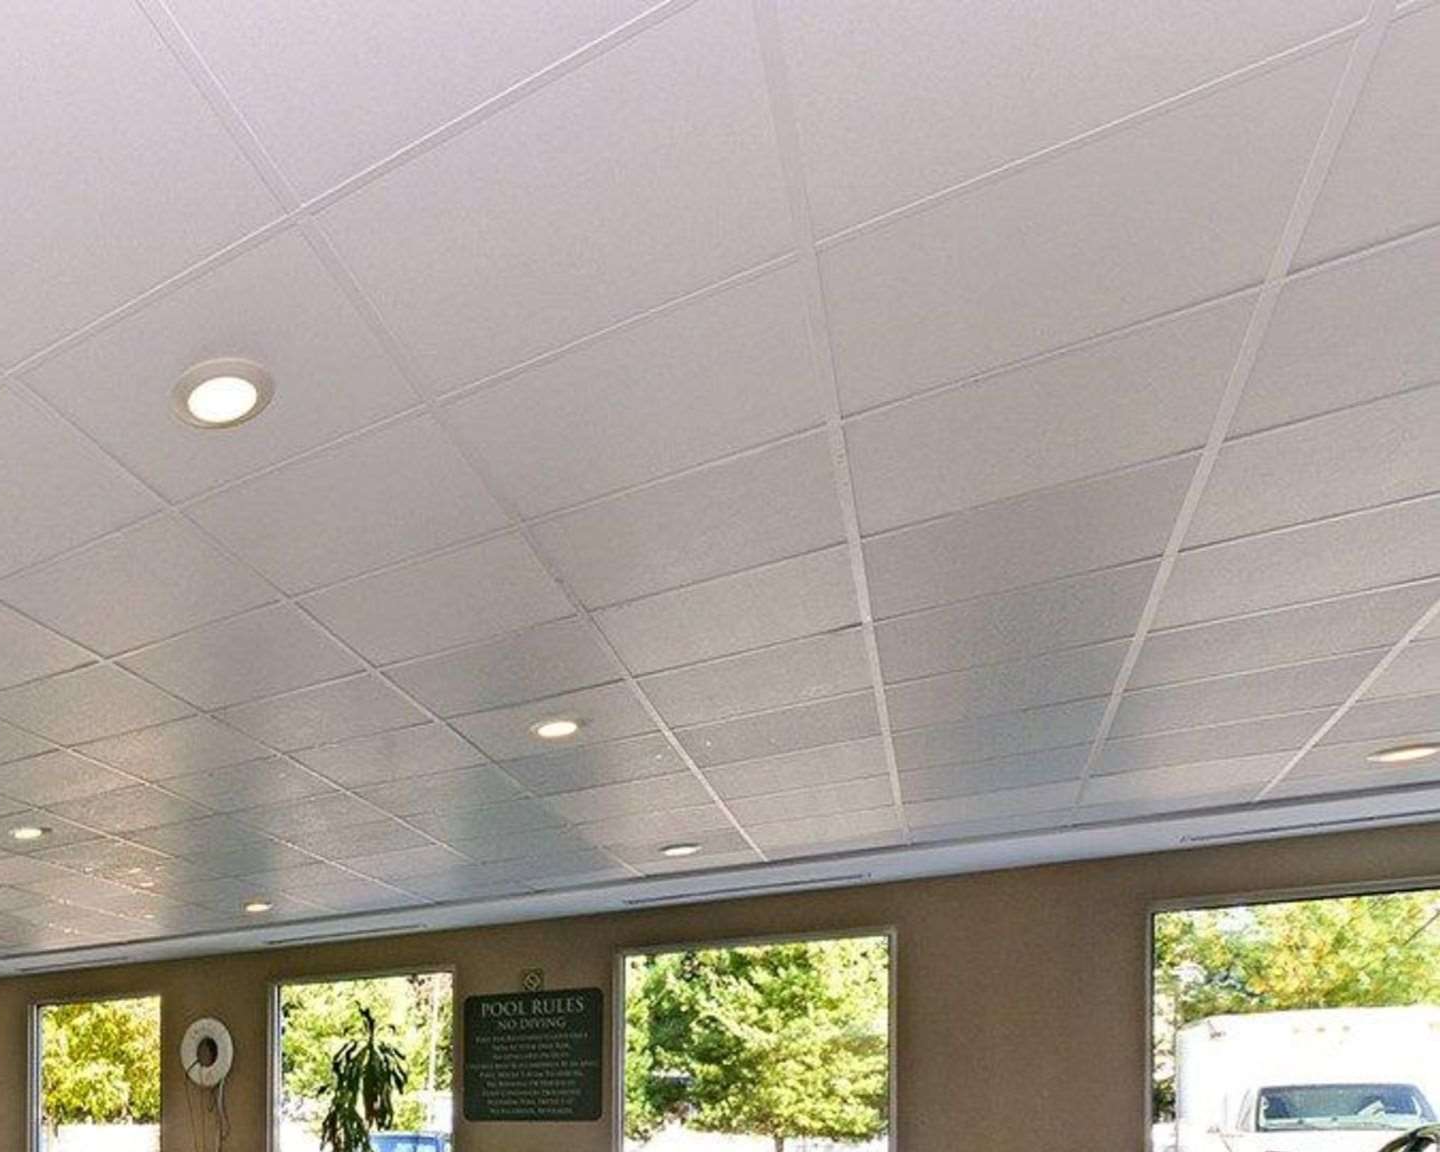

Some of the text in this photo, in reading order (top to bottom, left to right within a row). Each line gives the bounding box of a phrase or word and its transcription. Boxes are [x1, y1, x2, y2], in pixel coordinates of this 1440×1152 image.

[481, 997, 584, 1017] POOL RULES
[498, 1016, 566, 1030] NO DIVING
